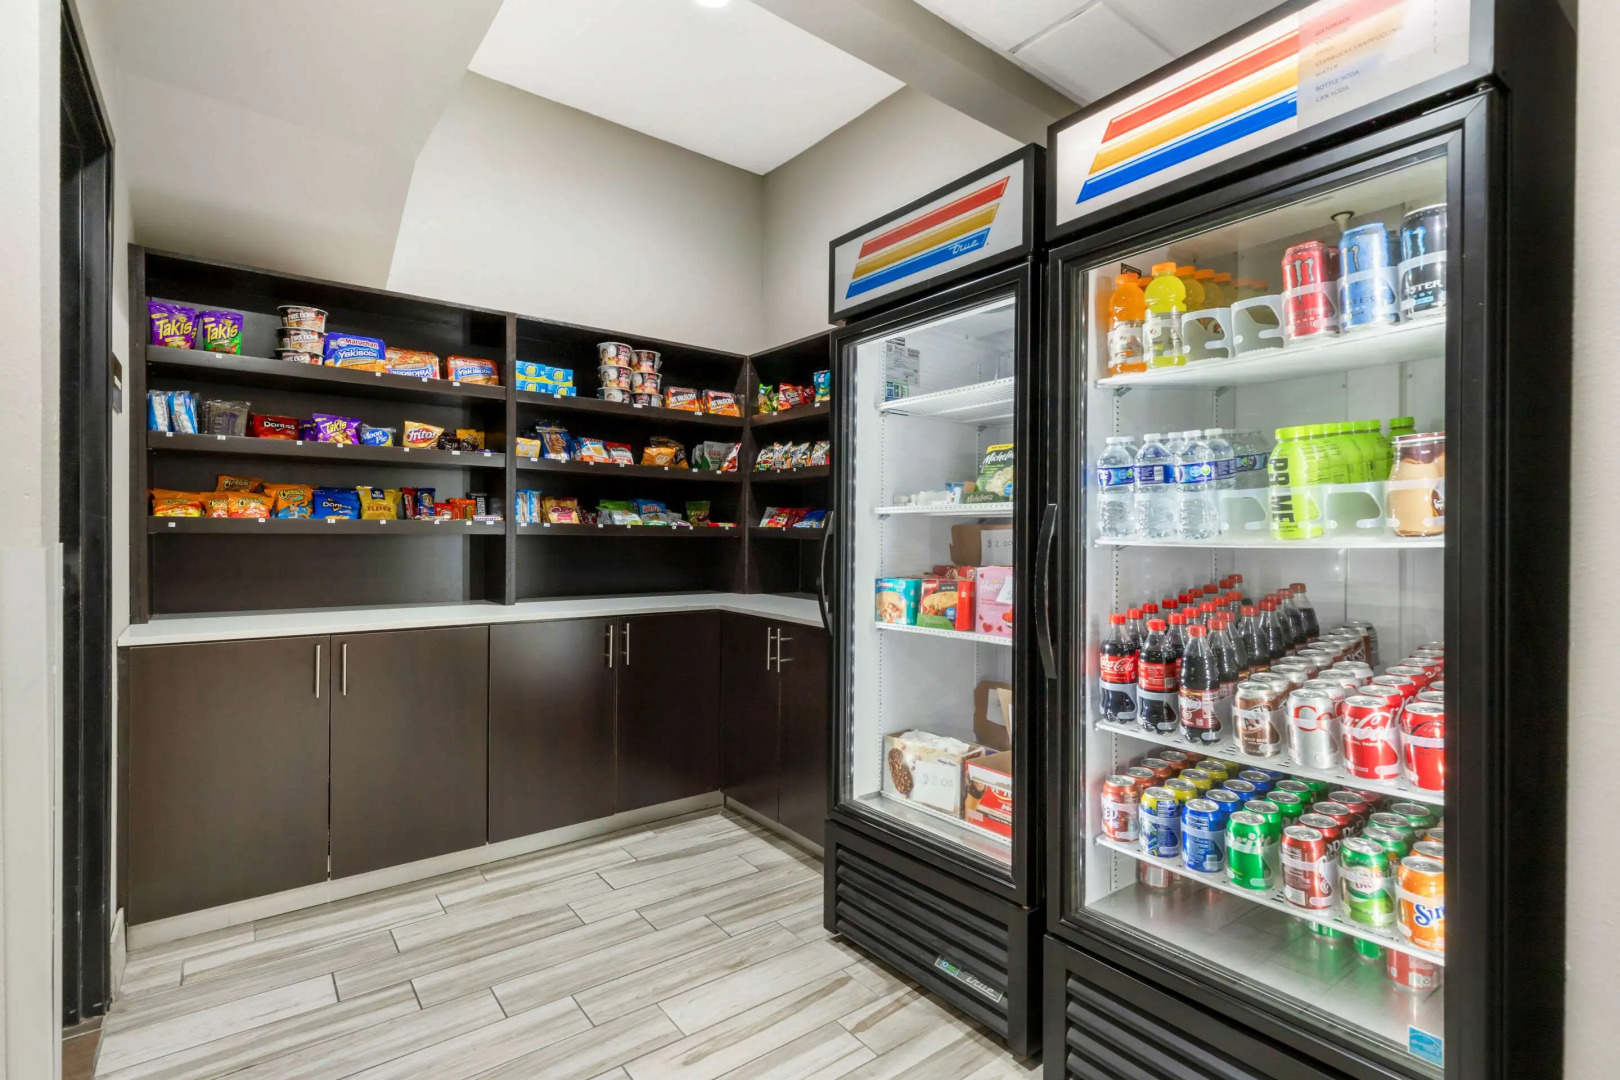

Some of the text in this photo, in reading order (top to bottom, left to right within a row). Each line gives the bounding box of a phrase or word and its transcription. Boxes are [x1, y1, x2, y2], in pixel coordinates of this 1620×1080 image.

[1315, 70, 1360, 91] BOTTLE SODA
[1315, 85, 1350, 103] CAN SODA
[155, 319, 193, 340] Takis
[204, 324, 239, 343] Takis
[345, 338, 379, 349] Maruchan
[337, 349, 378, 359] Yakisoba
[263, 420, 296, 431] Doritos
[325, 420, 347, 435] Takis
[375, 434, 388, 444] Pie
[406, 427, 436, 443] Fritos
[278, 489, 307, 500] Cheetos
[322, 501, 353, 512] Doritos
[367, 503, 393, 514] BBQ
